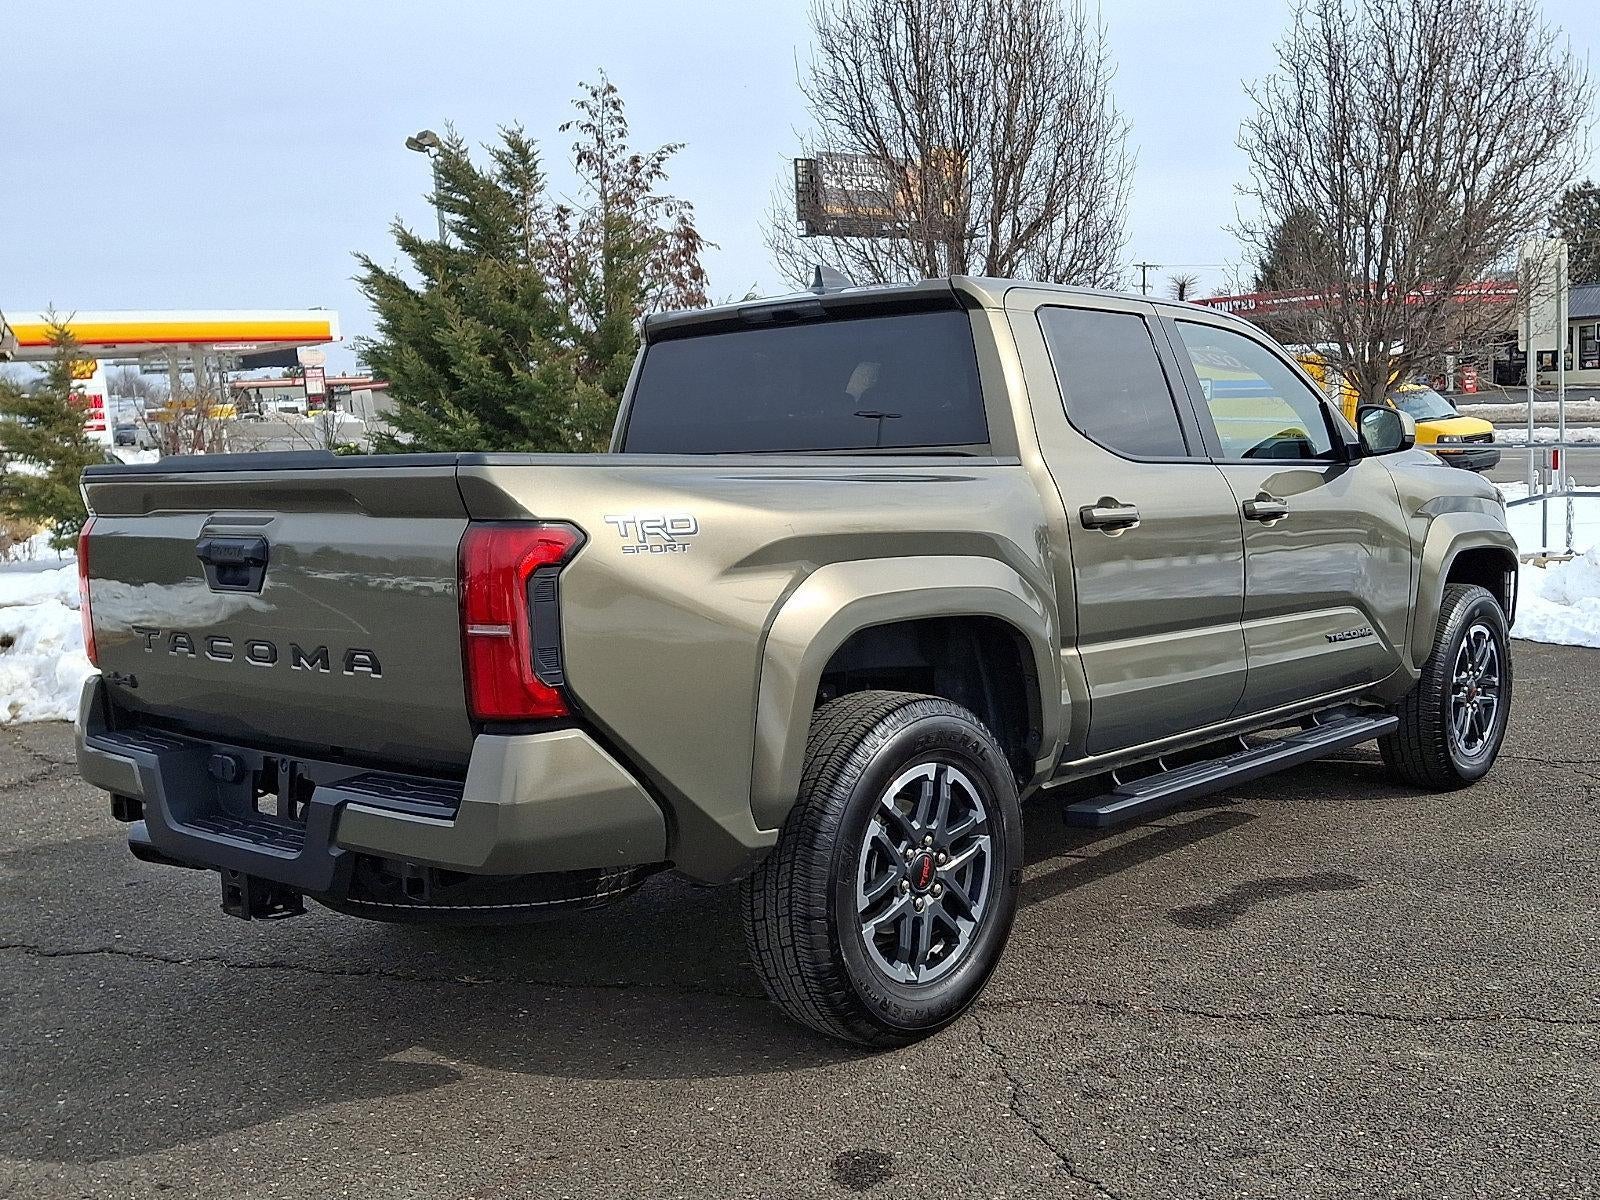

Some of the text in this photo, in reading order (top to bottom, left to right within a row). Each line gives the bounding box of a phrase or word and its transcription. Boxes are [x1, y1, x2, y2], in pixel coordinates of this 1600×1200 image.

[853, 157, 875, 174] this
[603, 513, 699, 543] TRD
[621, 542, 691, 554] SPORT
[1325, 627, 1373, 643] TACOMA
[131, 625, 382, 679] TACOMA
[919, 856, 930, 887] TRD
